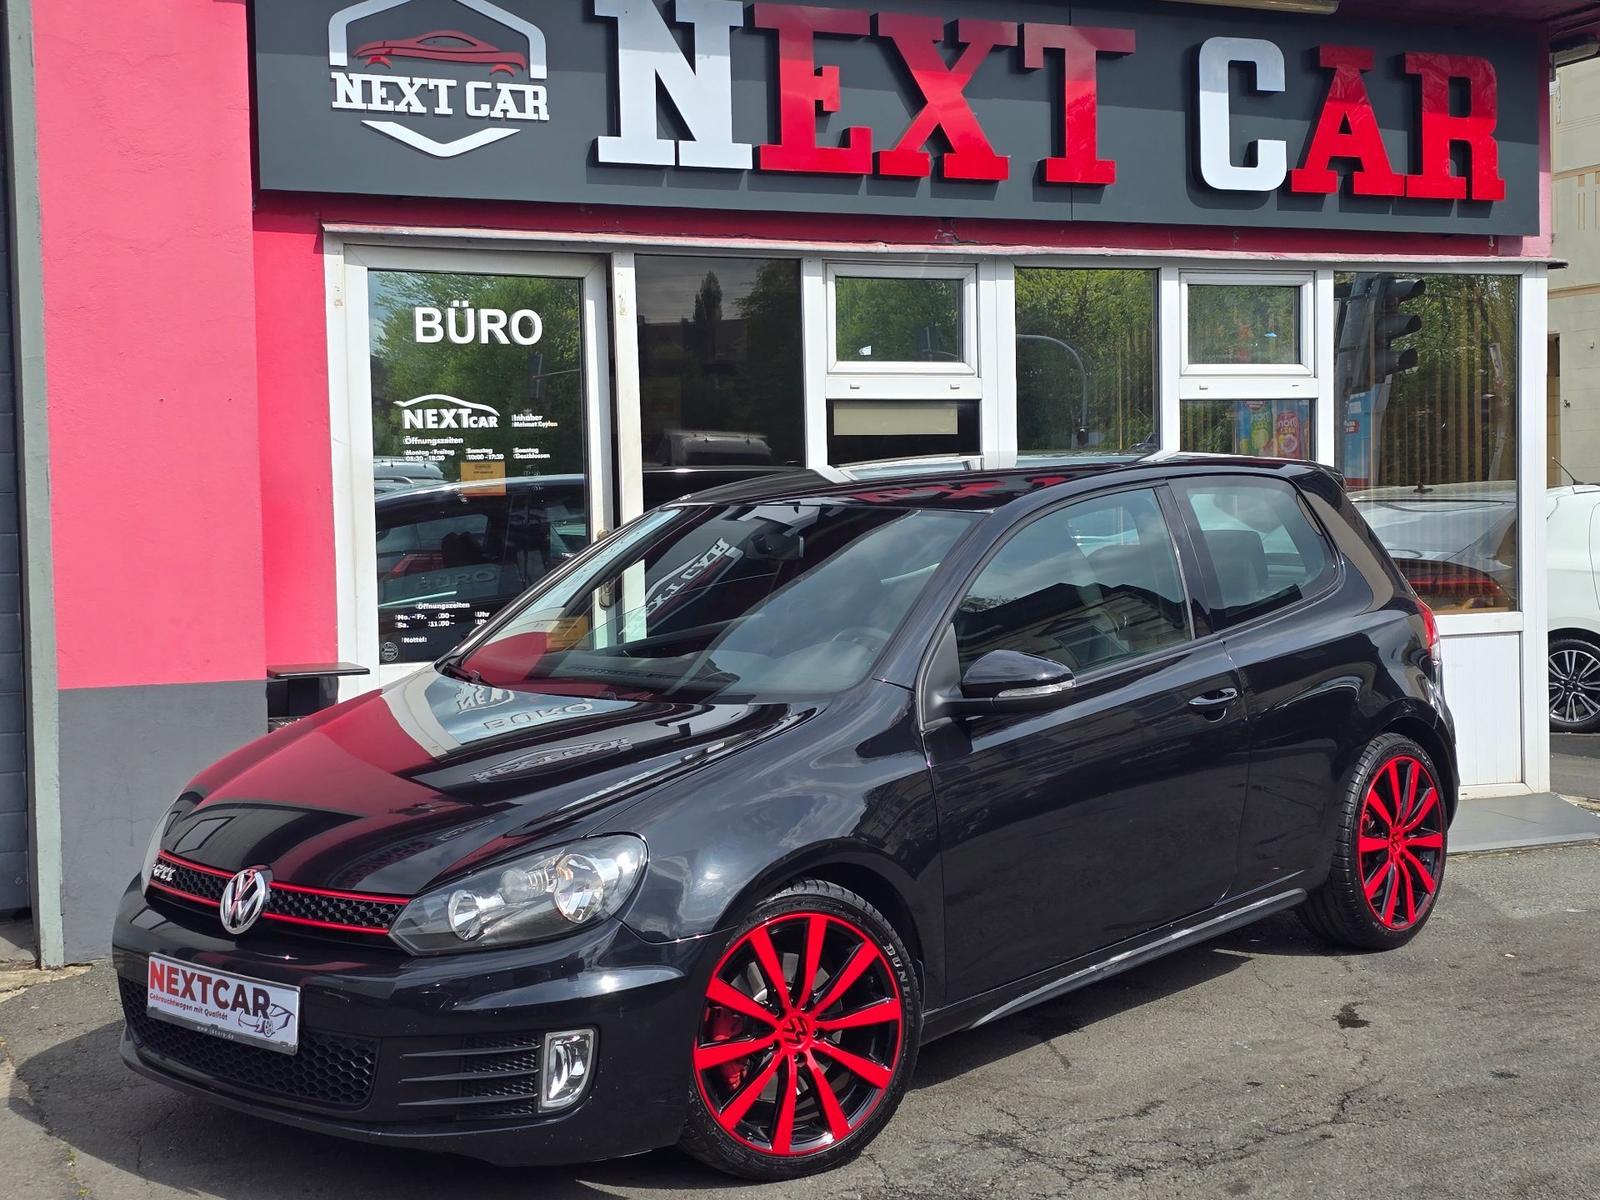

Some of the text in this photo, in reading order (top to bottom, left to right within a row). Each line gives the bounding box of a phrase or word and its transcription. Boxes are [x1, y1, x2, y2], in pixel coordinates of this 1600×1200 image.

[331, 72, 549, 120] NEXT CAR
[594, 0, 1505, 201] NEXT CAR
[414, 300, 543, 345] BÜRO
[512, 413, 543, 421] Inhaber
[403, 436, 464, 446] Öffnungszeiten
[416, 602, 470, 610] Öffnungszeiten
[150, 993, 193, 1013] Gebrauchtwagen
[194, 1006, 203, 1014] mit
